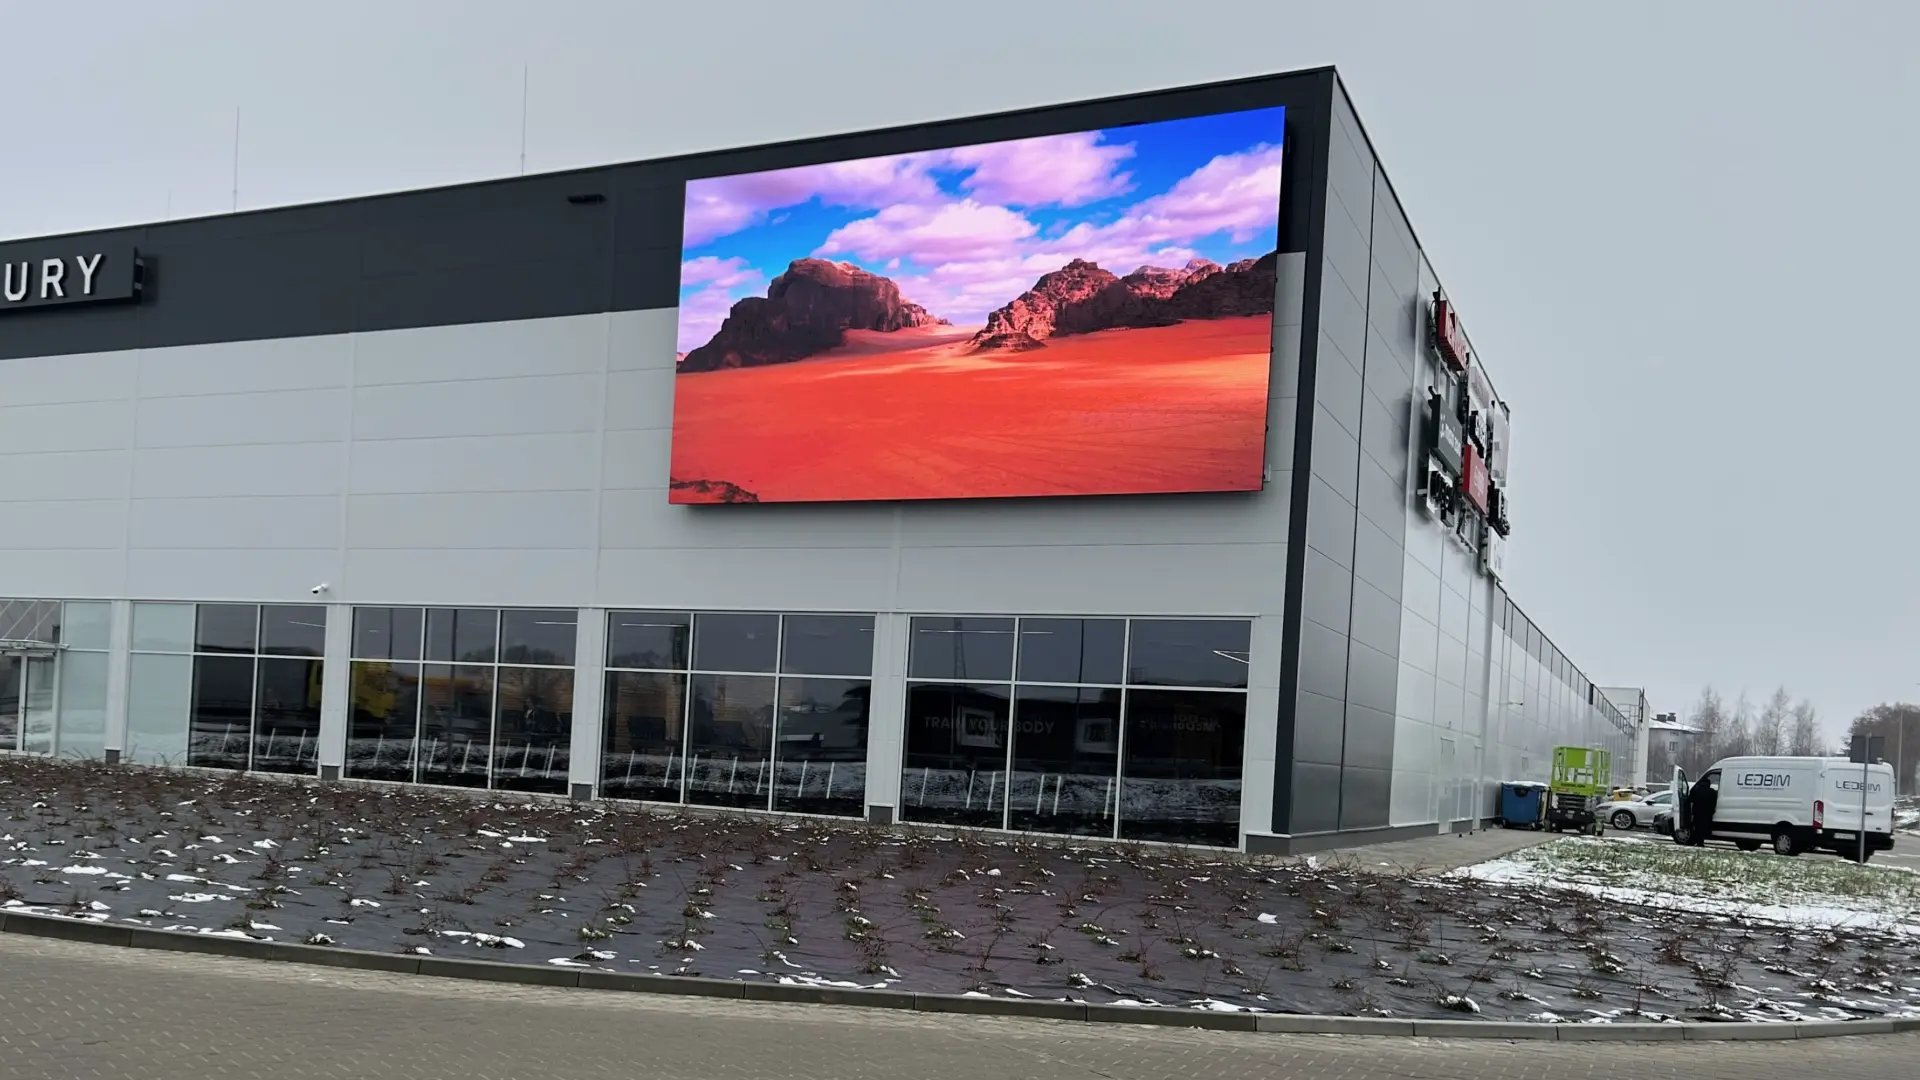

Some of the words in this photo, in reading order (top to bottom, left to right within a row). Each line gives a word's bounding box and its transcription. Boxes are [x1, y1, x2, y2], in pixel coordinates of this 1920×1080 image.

[4, 253, 102, 302] URY
[968, 718, 1008, 733] YOUR
[1013, 719, 1055, 735] BODY
[1737, 773, 1791, 787] LEDBIM
[1835, 780, 1881, 792] LEDBIM
